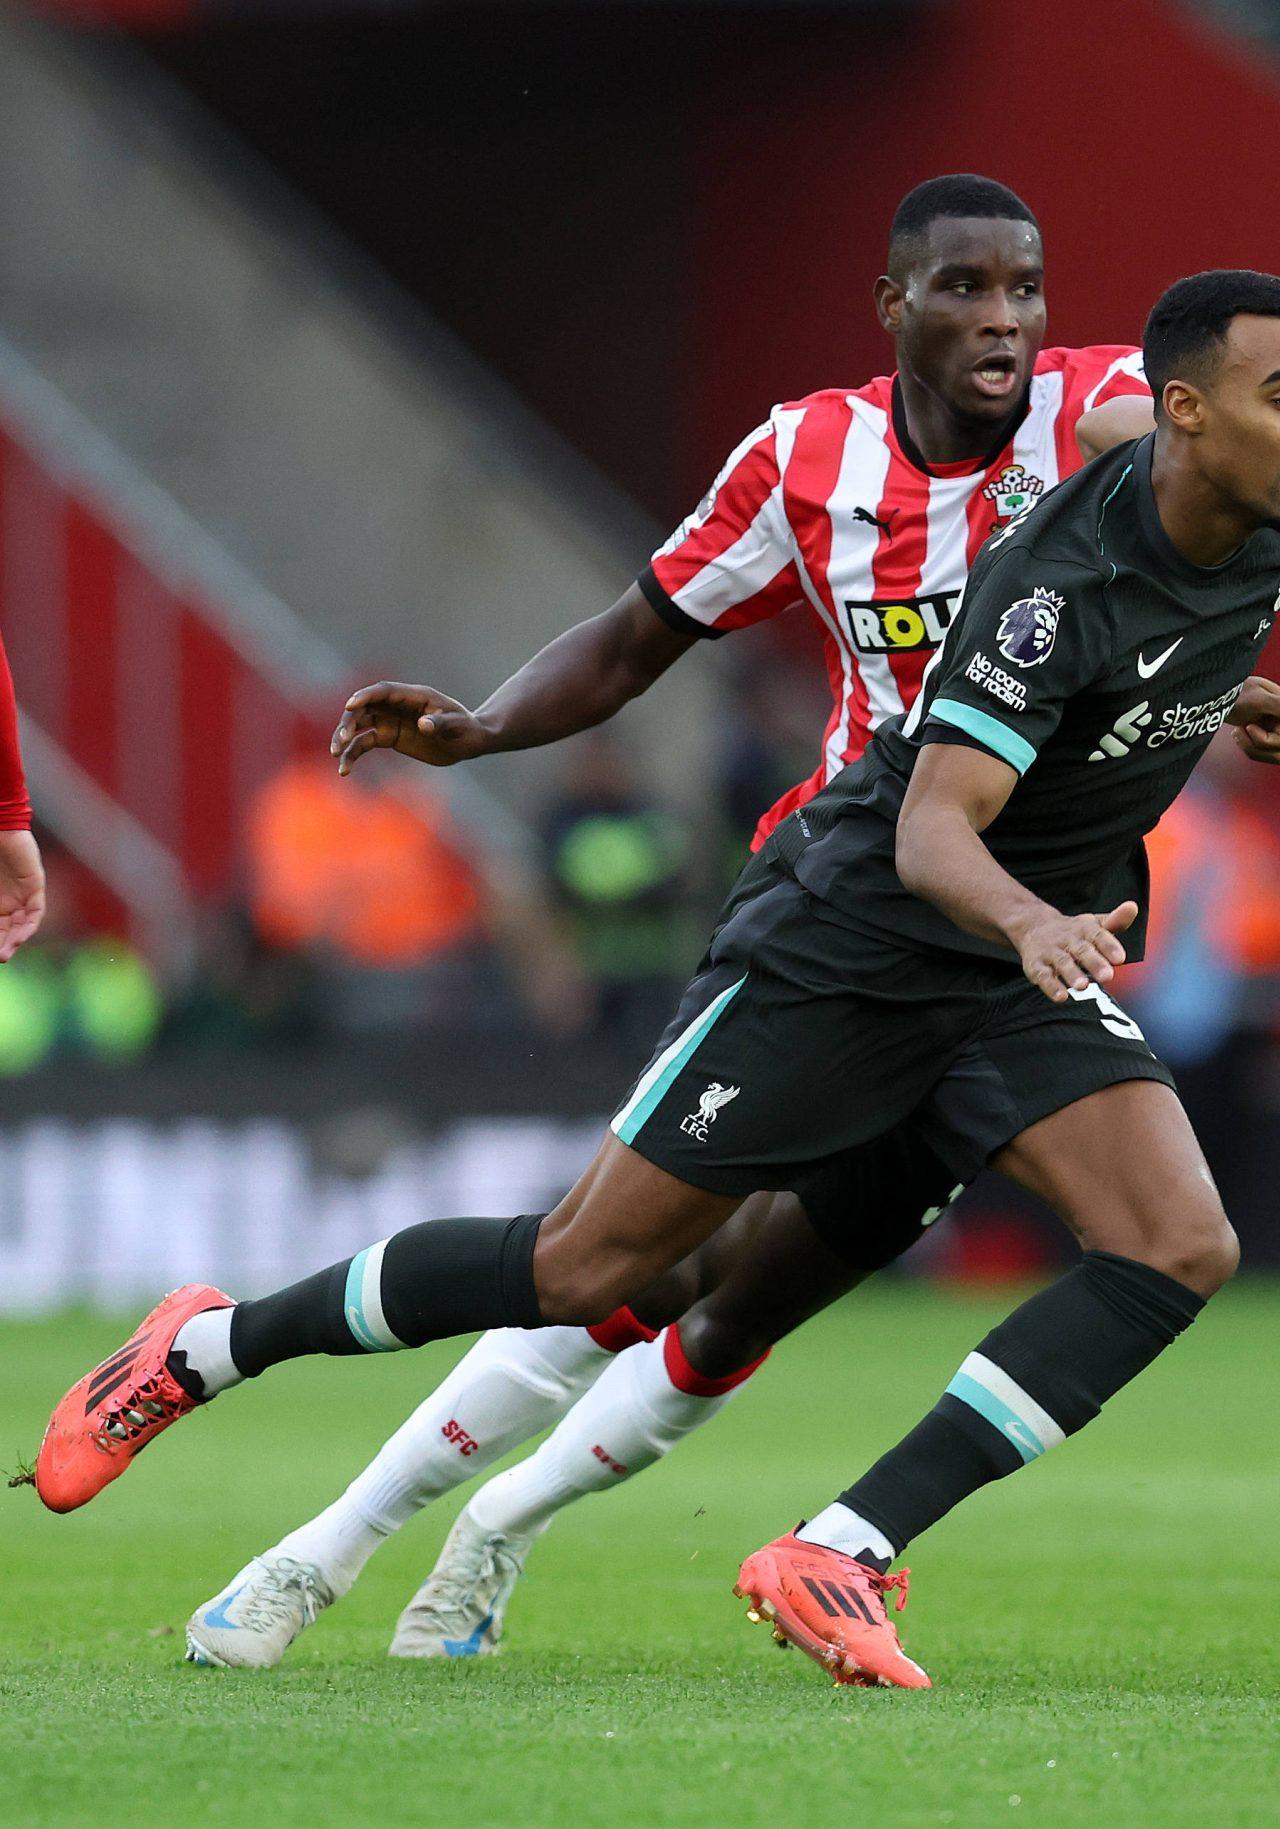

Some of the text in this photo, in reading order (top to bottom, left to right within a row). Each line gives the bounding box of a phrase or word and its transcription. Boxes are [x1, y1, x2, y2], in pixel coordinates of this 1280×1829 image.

[965, 663, 1027, 712] for racism
[971, 651, 1027, 698] No room
[441, 1419, 479, 1457] SFC
